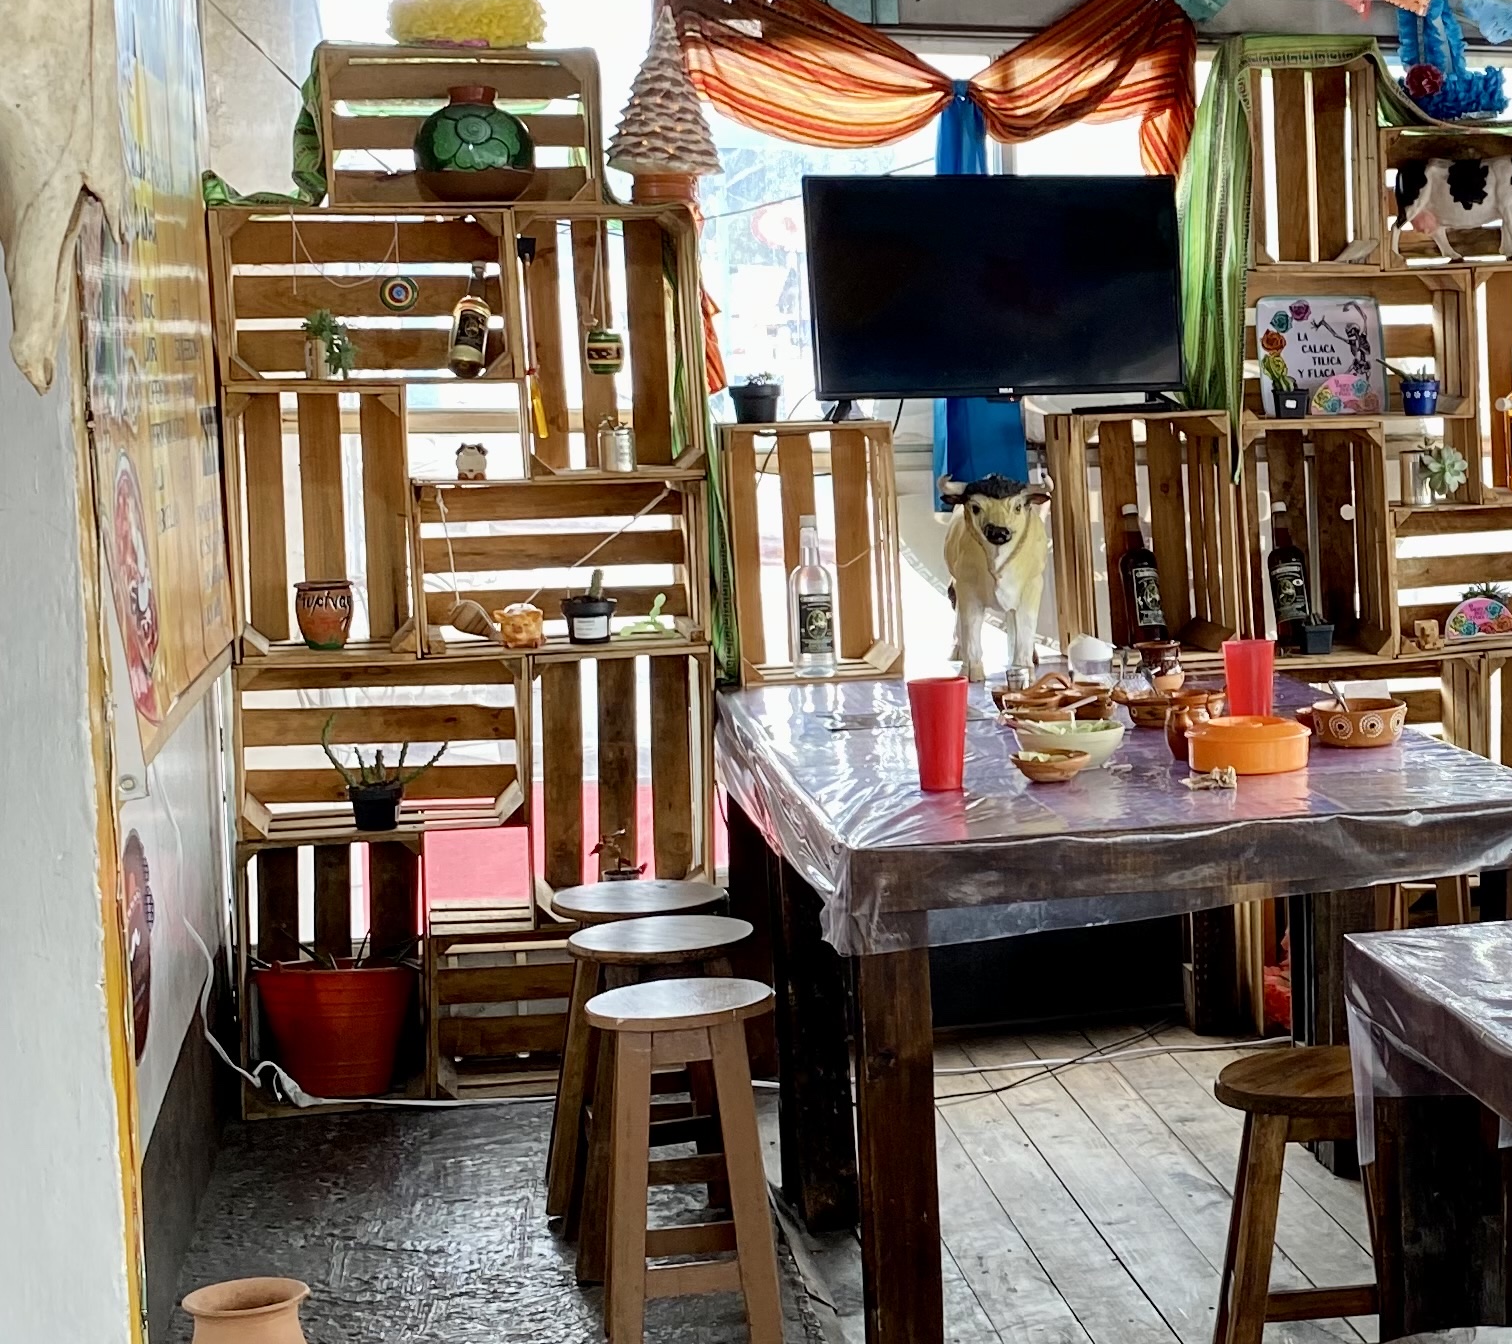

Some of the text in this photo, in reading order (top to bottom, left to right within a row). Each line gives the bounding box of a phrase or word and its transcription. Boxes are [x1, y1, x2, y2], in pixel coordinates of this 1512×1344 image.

[1297, 332, 1308, 341] LA
[1302, 344, 1335, 353] CALACA
[1312, 356, 1341, 365] TILICA
[1298, 368, 1335, 378] Y FLACA
